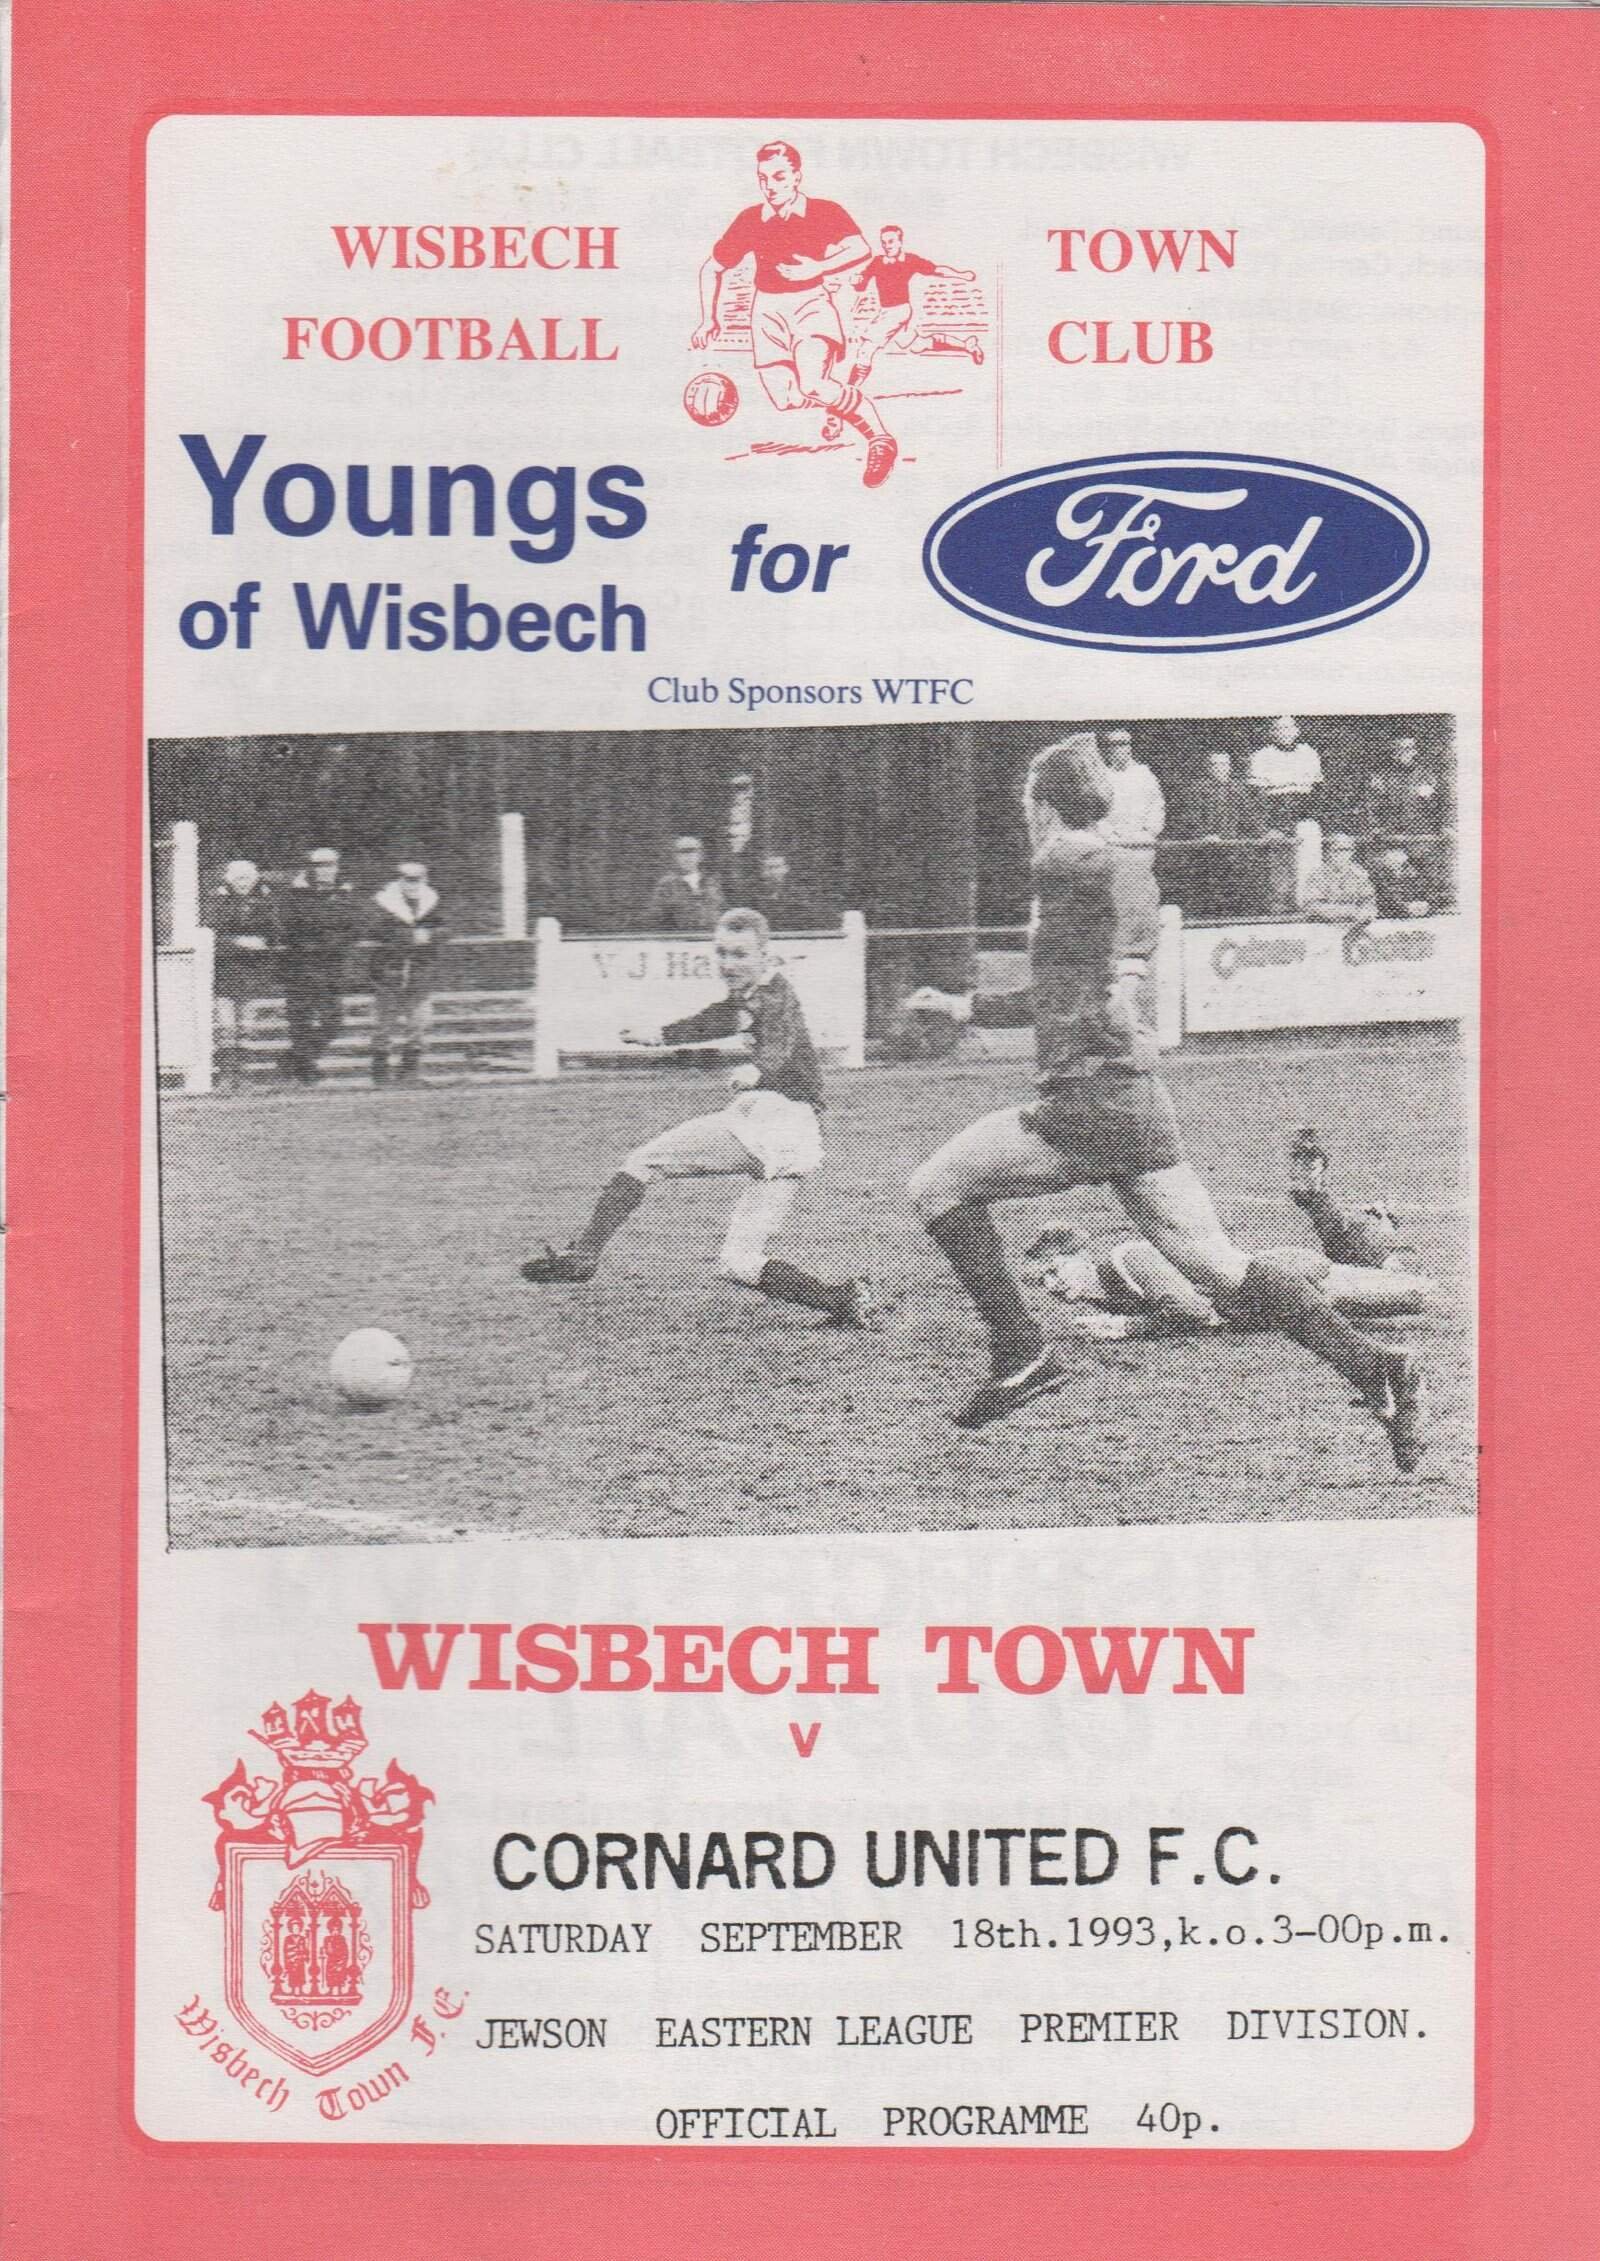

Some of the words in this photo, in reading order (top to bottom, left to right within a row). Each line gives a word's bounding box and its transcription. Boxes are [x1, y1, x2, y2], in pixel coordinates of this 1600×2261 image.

[333, 225, 617, 271] WISBECH
[1047, 228, 1236, 273] TOWN
[285, 317, 618, 361] FOOTBALL
[1048, 320, 1214, 365] CLUB
[180, 434, 647, 564] Youngs
[730, 524, 849, 594] for
[1025, 483, 1324, 607] Ford
[179, 581, 262, 652] of
[294, 582, 647, 654] Wisbech
[648, 676, 719, 704] Club
[728, 677, 862, 711] Sponsors
[873, 678, 975, 705] WTFC
[358, 1622, 880, 1696] WISBECH
[925, 1624, 1256, 1696] TOWN
[493, 1831, 836, 1892] CORNARD
[865, 1827, 1119, 1889] UNITED
[1148, 1825, 1282, 1887] F.C.
[475, 1923, 652, 1954] SATURDAY
[700, 1920, 903, 1953] SEPTEMBER
[174, 1993, 290, 2113] Wisbech
[315, 2061, 411, 2121] Town
[476, 2018, 608, 2049] JEWSON
[655, 2016, 813, 2048] EASTERN
[836, 2014, 973, 2046] LEAGUE
[1019, 2011, 1179, 2044] PREMIER
[1226, 2008, 1427, 2040] DIVISION.
[656, 2105, 837, 2140] OFFICIAL
[882, 2104, 1089, 2137] PROGRAMME
[1136, 2102, 1220, 2140] 40p.
